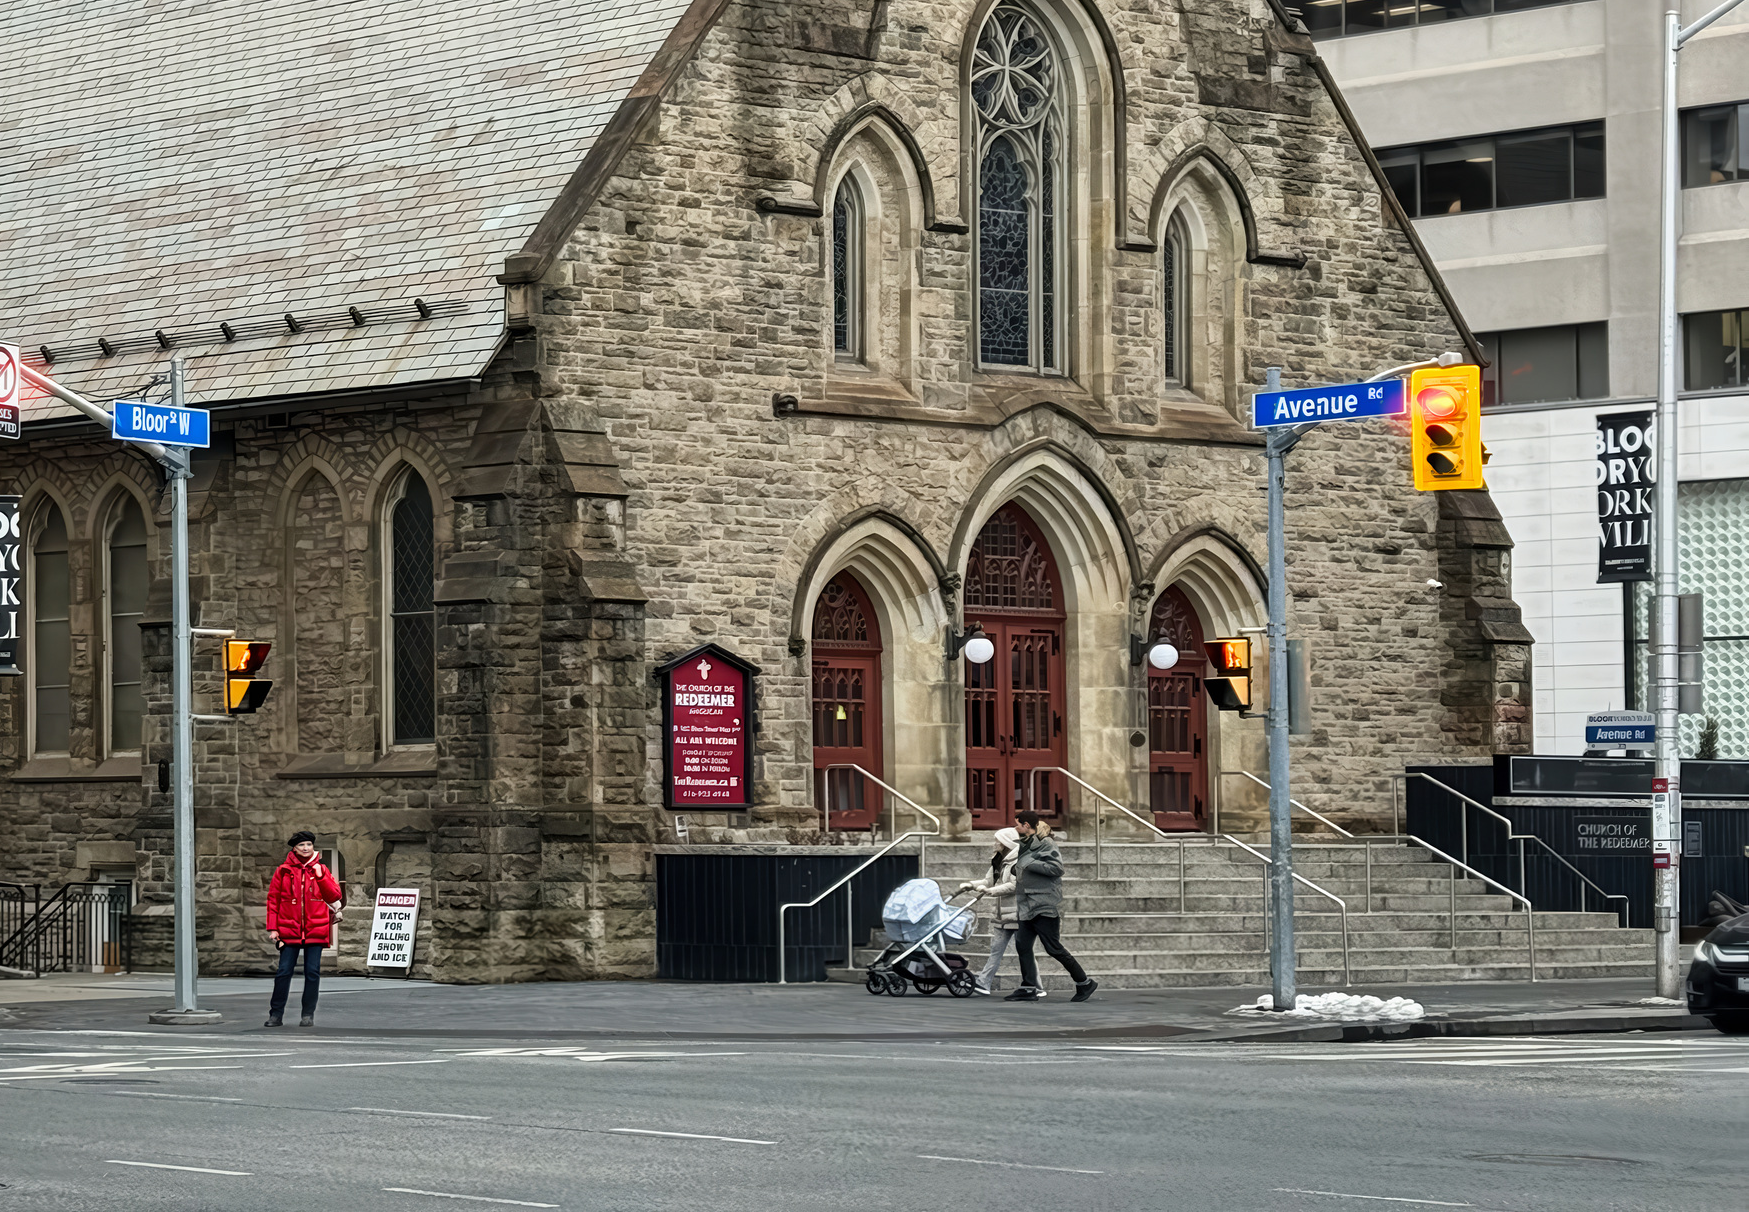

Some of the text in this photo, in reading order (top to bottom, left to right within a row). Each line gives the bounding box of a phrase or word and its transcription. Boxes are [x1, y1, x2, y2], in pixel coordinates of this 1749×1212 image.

[1274, 387, 1384, 420] Avenue Rd
[132, 406, 169, 434] Bloor
[179, 411, 191, 436] W
[675, 693, 735, 707] REDEEMER
[1596, 728, 1633, 740] Avenue
[675, 736, 688, 744] ALL
[1577, 823, 1637, 836] CHURCH OF
[1577, 837, 1651, 848] THE REDEEMER
[379, 895, 415, 905] DANGER
[379, 911, 410, 920] WATCH
[384, 922, 403, 931] FOR
[373, 932, 410, 941] FALLING
[377, 942, 405, 951] SNOW
[371, 953, 408, 962] AND ICE
